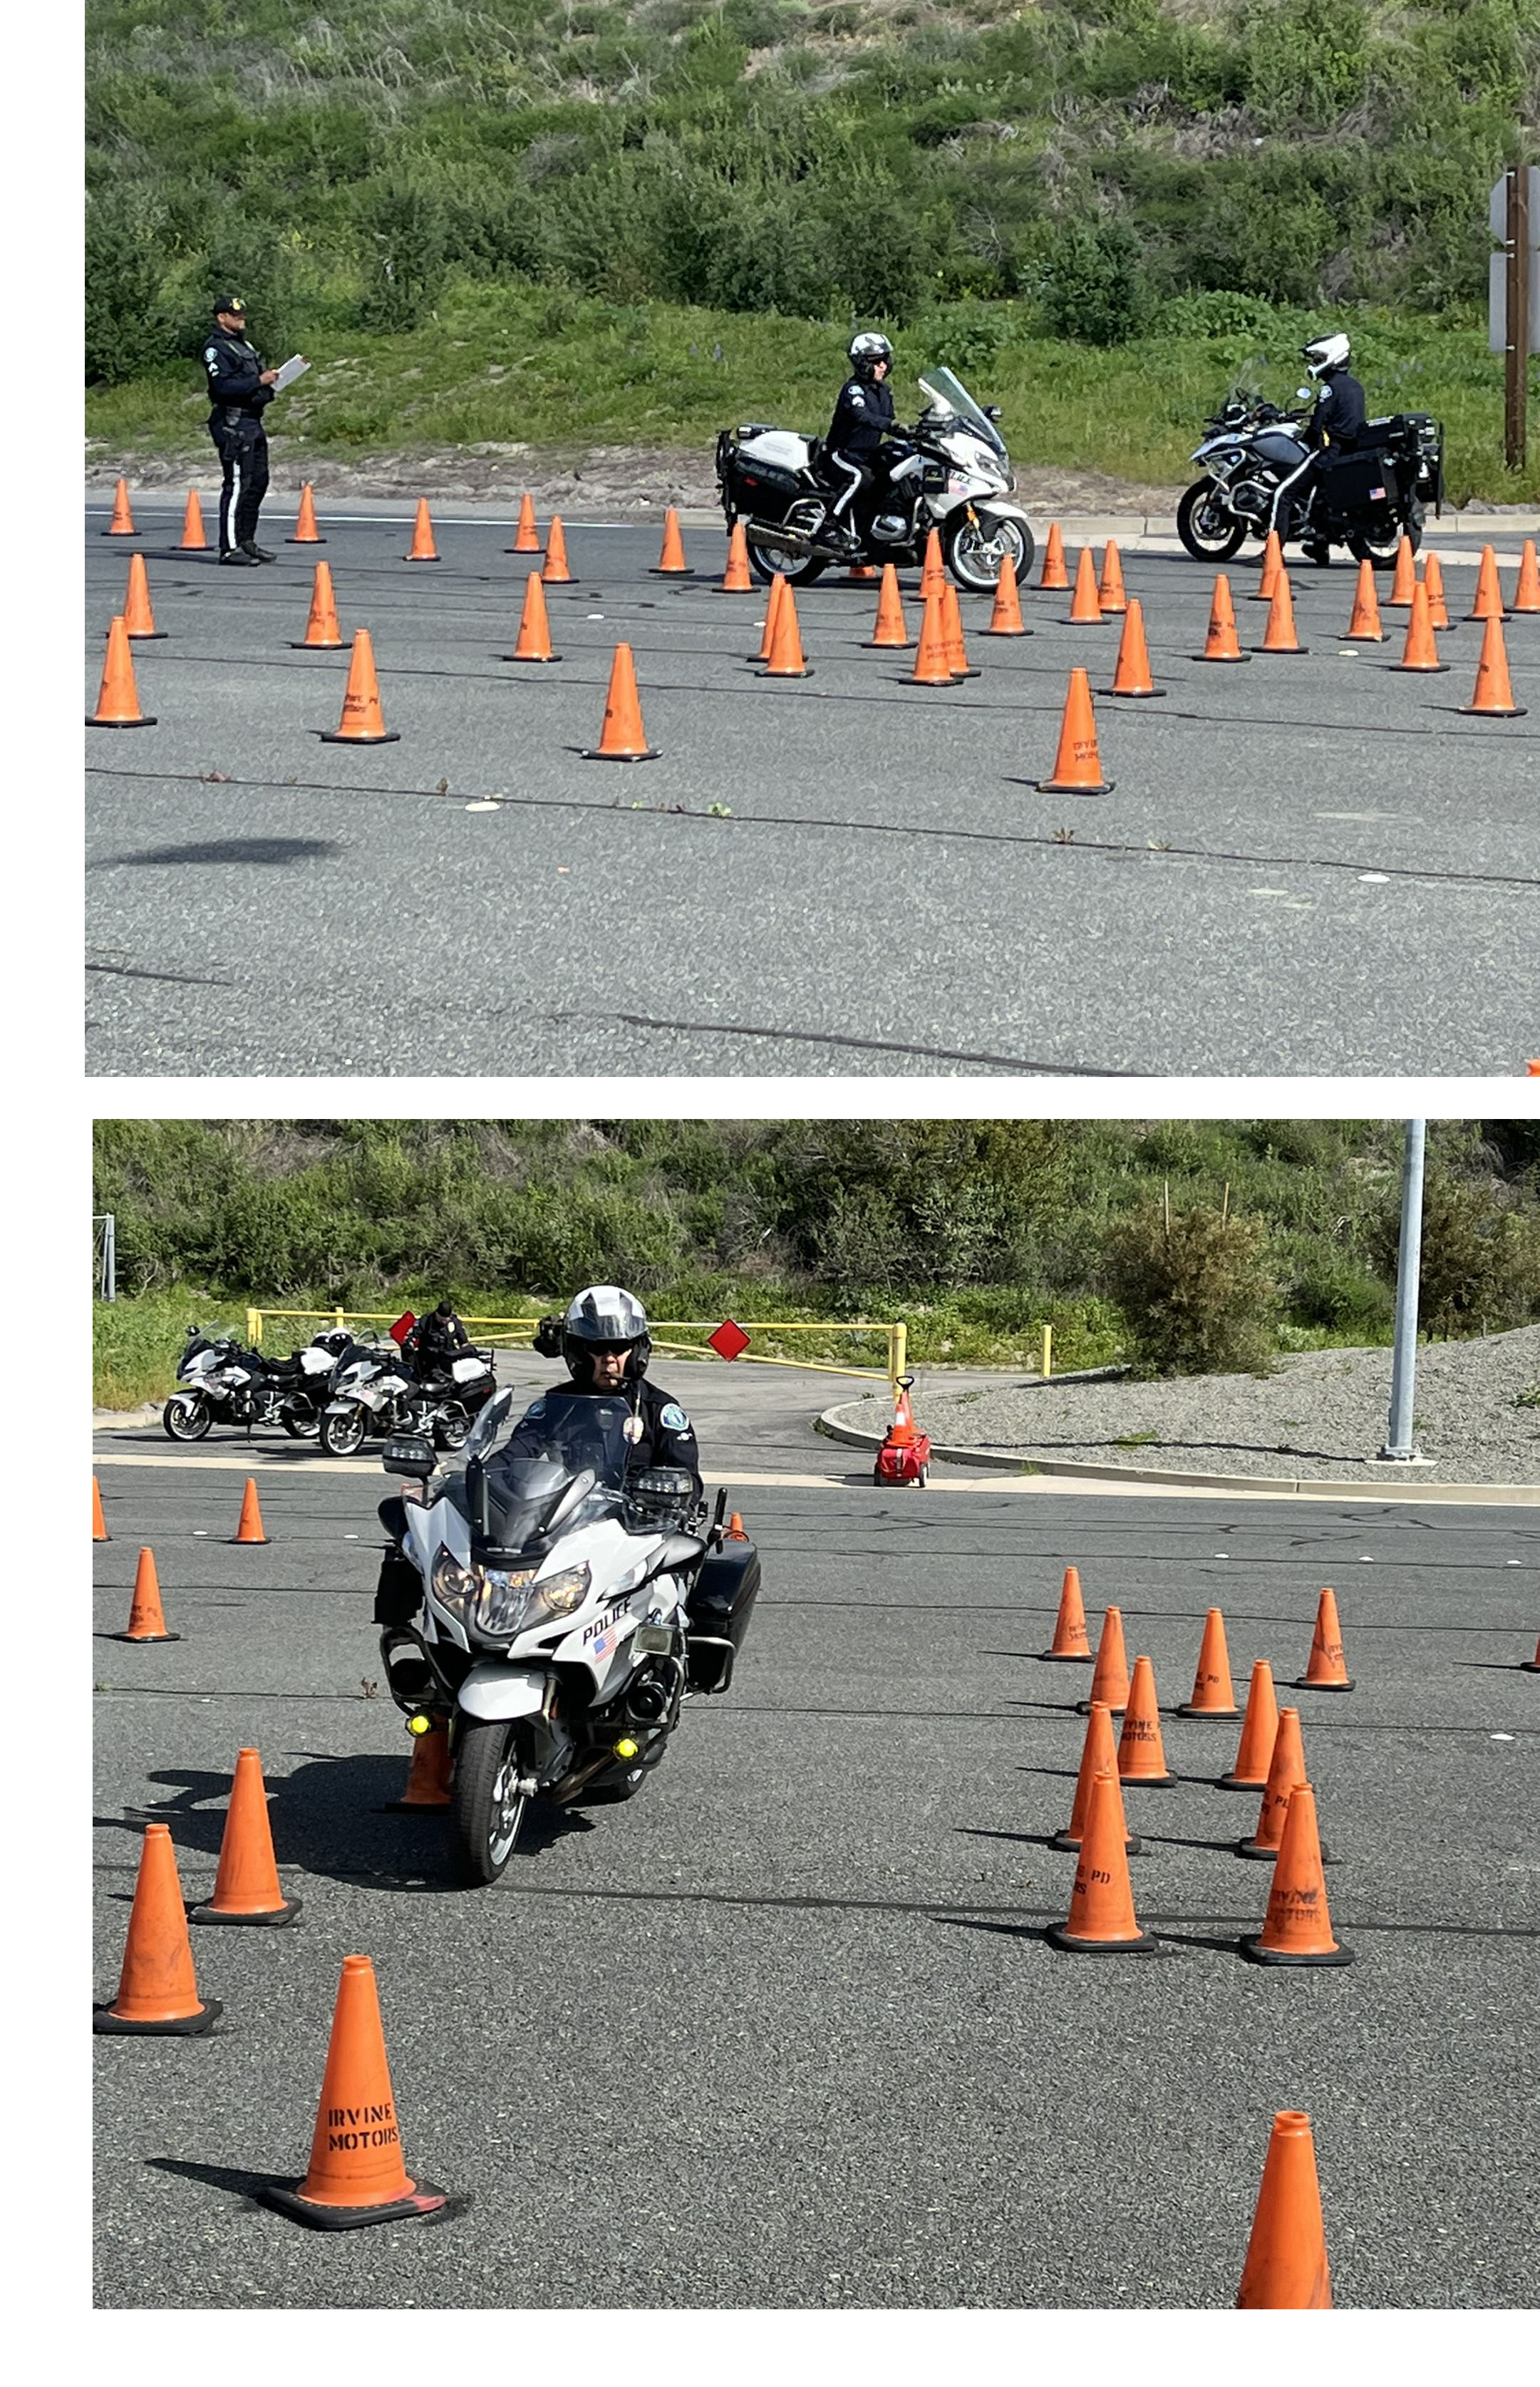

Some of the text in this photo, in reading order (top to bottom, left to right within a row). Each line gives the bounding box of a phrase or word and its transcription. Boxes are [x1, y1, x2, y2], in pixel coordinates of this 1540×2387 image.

[583, 1596, 631, 1646] POLICE
[1091, 1869, 1111, 1885] PD
[329, 2103, 392, 2127] IRVINE
[329, 2126, 398, 2151] MOTORS
